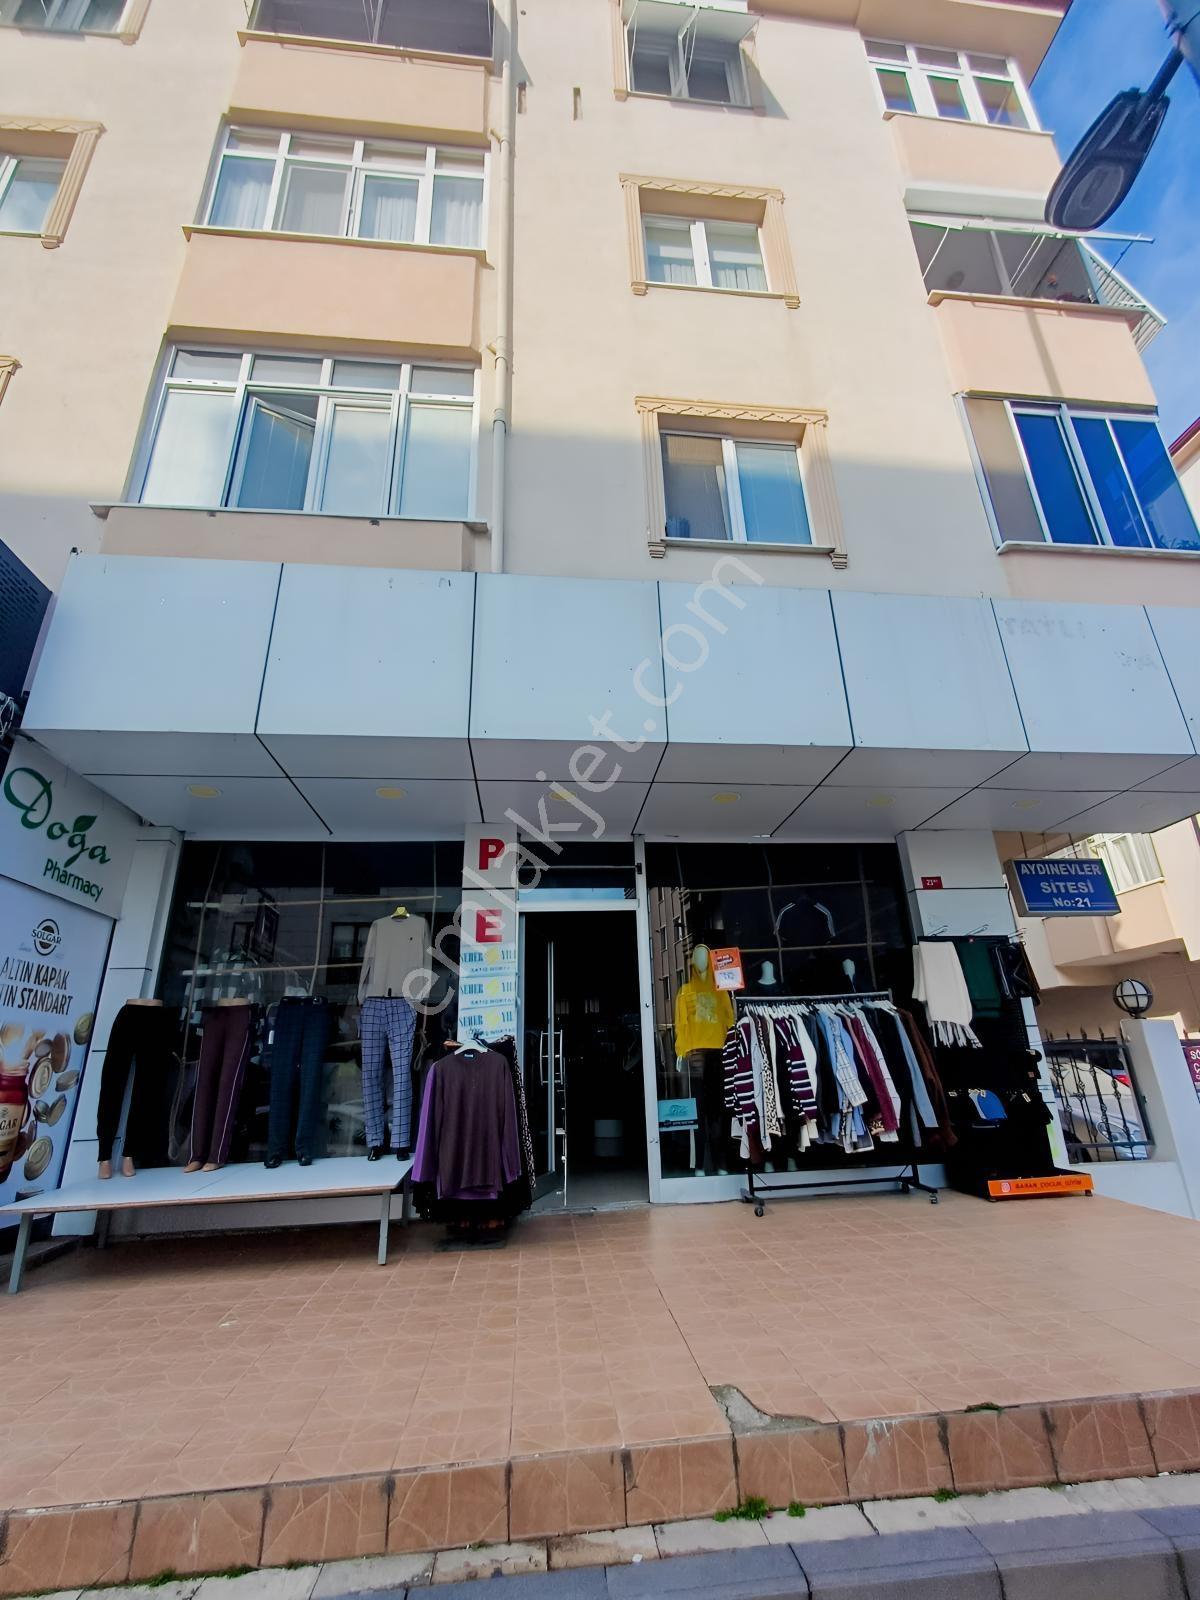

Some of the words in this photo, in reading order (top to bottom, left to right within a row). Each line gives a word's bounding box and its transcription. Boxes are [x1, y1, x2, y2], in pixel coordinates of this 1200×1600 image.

[1021, 863, 1101, 876] AYDINEVLER
[43, 858, 104, 902] Pharmacy
[1040, 879, 1094, 894] SİTESİ
[1053, 897, 1091, 908] No:21
[31, 928, 62, 945] SOLGAR
[0, 957, 34, 982] ALTIN
[34, 963, 70, 990] KAPAK
[18, 987, 73, 1016] STANDART
